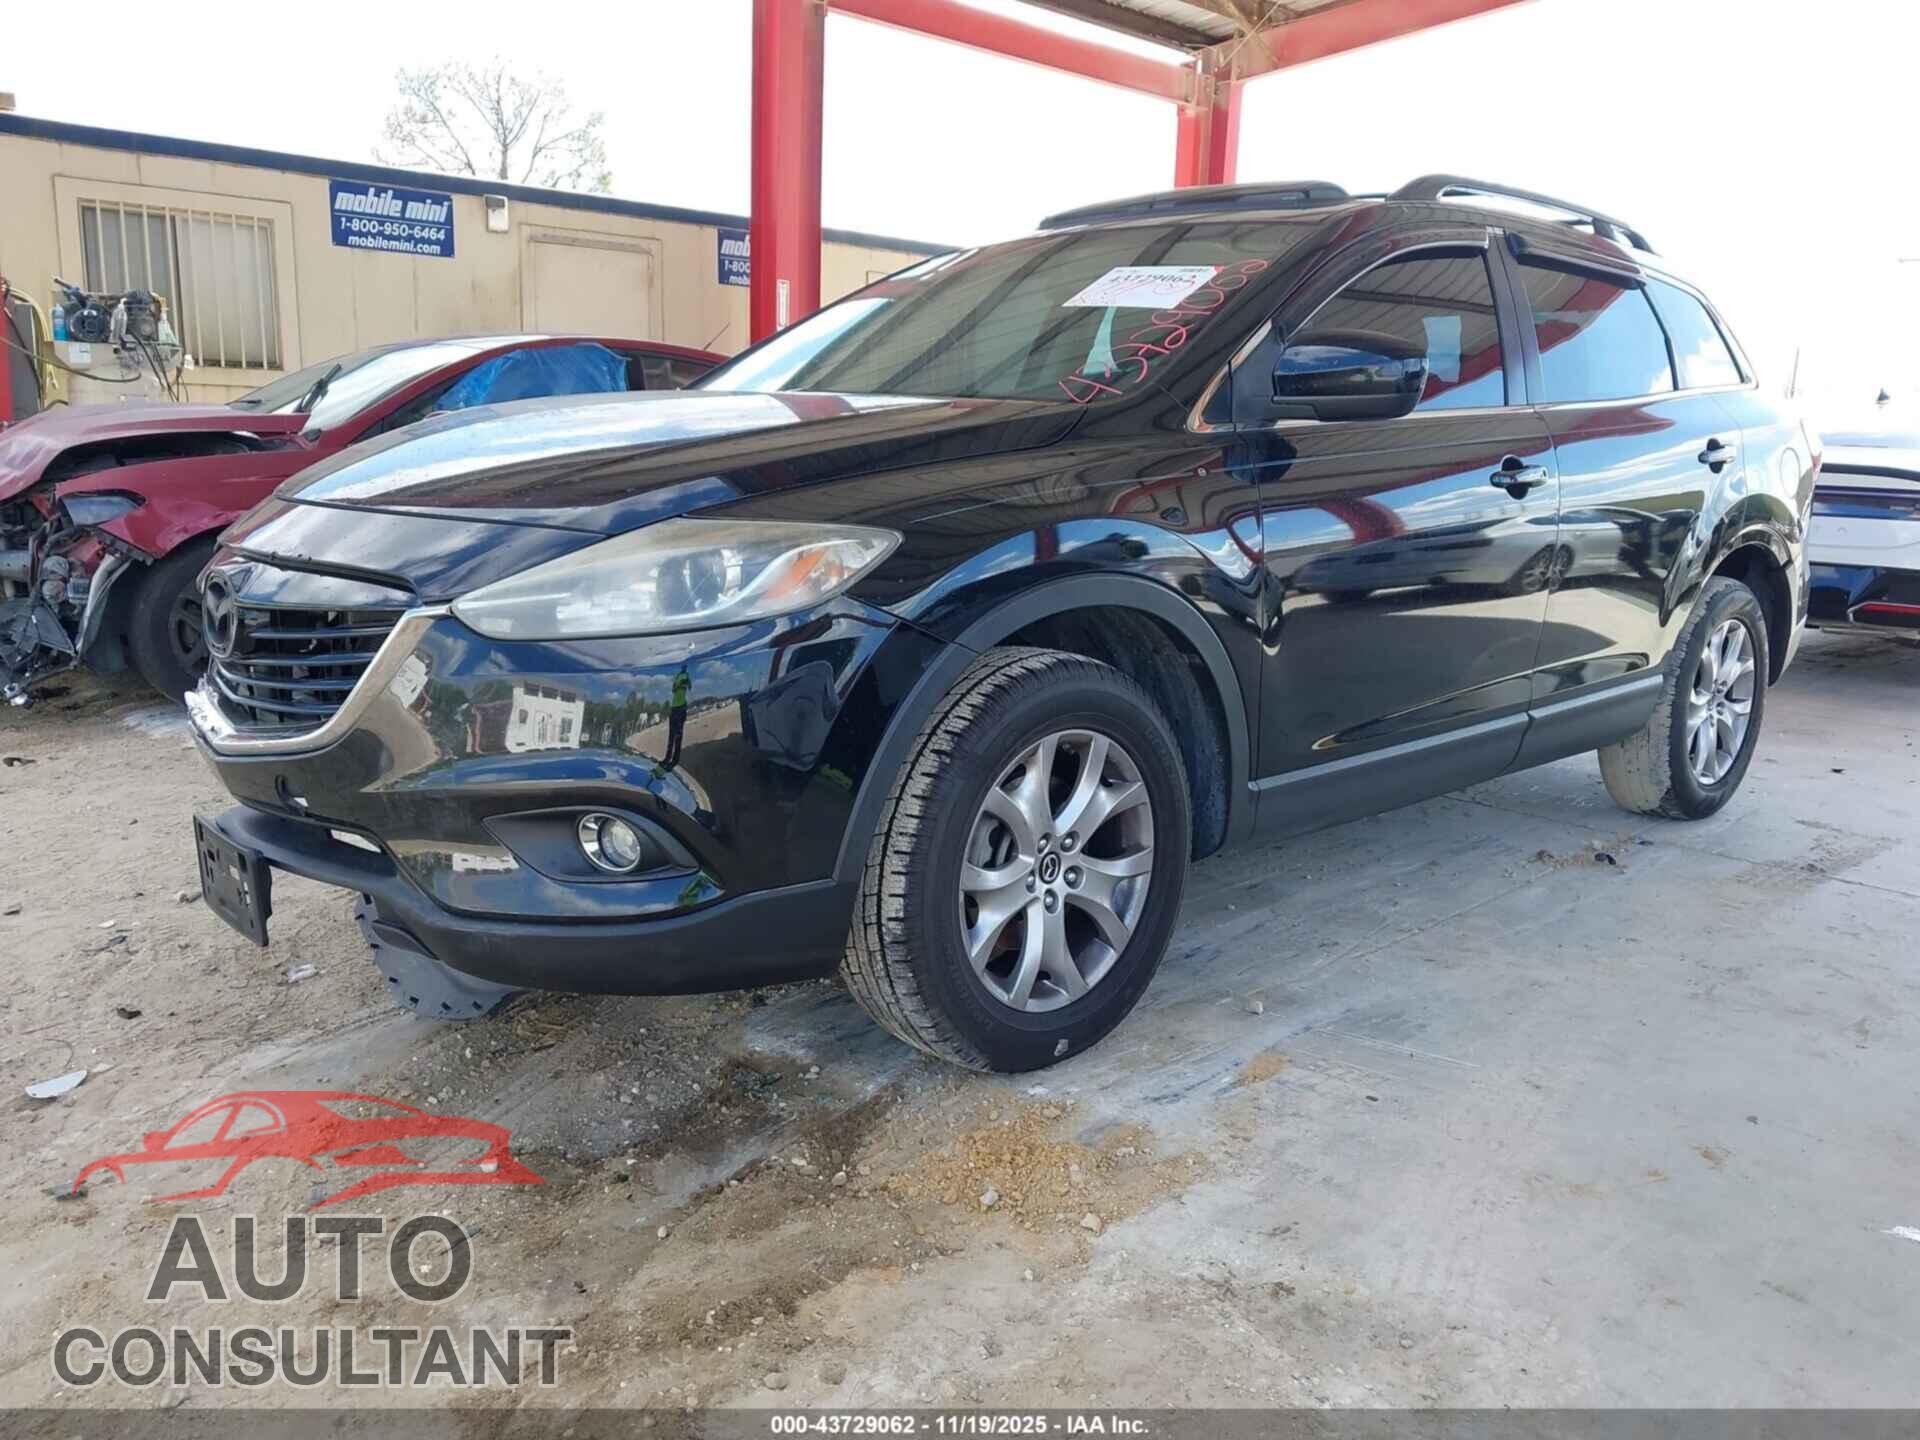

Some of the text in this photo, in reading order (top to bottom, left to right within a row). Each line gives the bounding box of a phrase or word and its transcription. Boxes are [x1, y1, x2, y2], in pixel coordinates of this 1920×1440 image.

[334, 187, 449, 223] mobile mini
[340, 217, 446, 241] 1-800-950-6464
[347, 235, 441, 254] mobilemini.com
